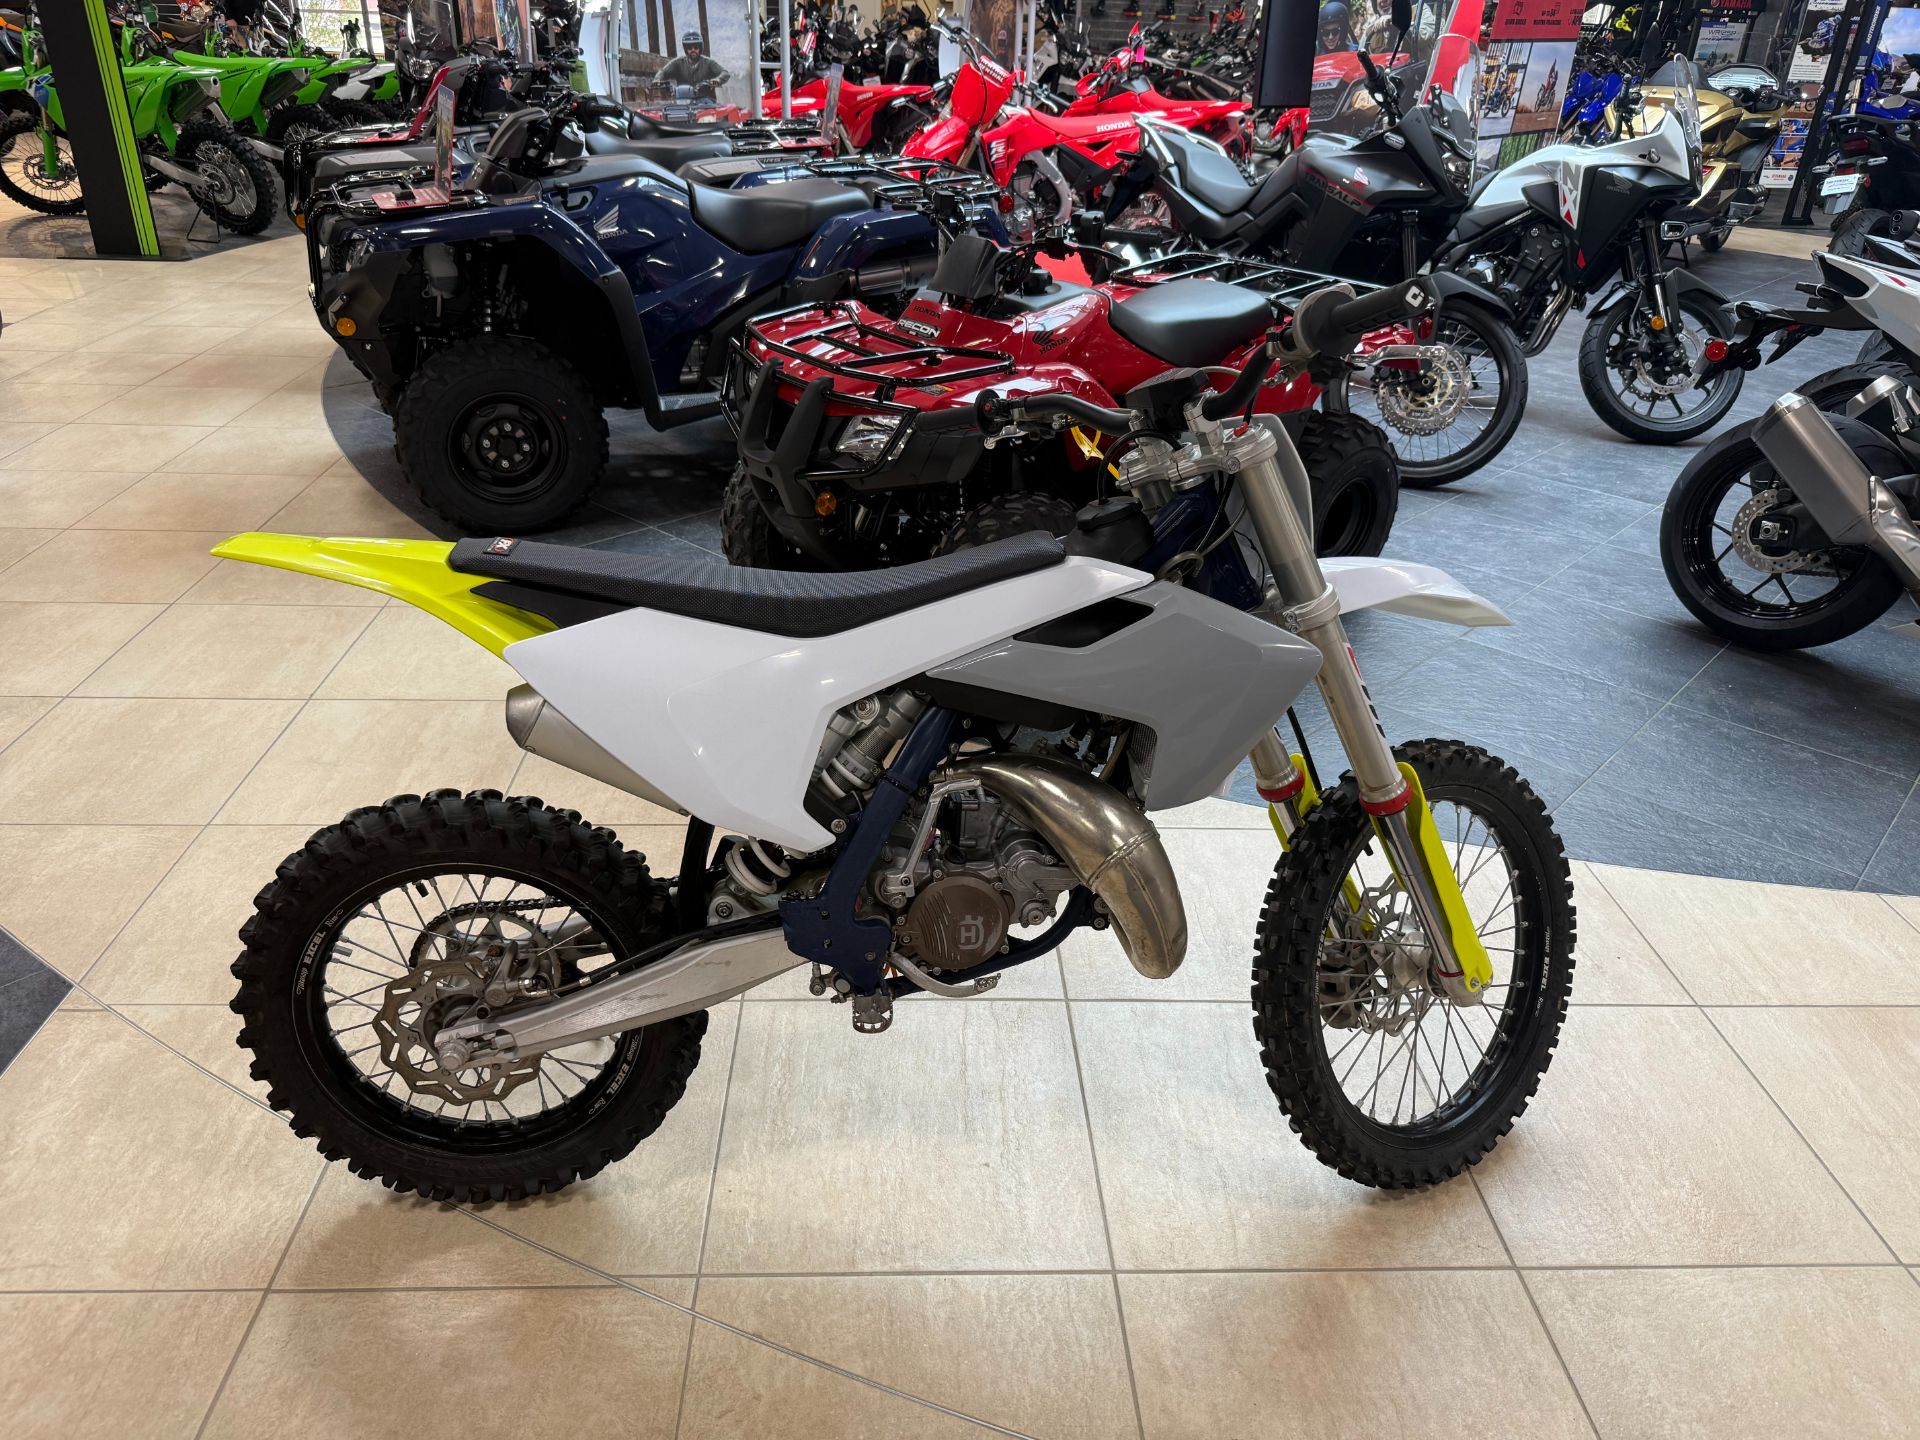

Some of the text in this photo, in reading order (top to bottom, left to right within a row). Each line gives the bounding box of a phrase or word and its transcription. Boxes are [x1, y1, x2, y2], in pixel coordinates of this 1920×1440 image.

[1719, 0, 1752, 8] YAMAHA
[1866, 5, 1880, 44] MOTOCROSS
[1096, 121, 1131, 132] HONDA
[597, 229, 629, 241] HONDA
[913, 305, 941, 319] HONDA
[897, 319, 941, 338] RECON
[1039, 336, 1069, 355] HONDA
[303, 931, 327, 965] EXCEL
[1540, 956, 1550, 992] EXCEL
[606, 1062, 631, 1095] EXCEL
